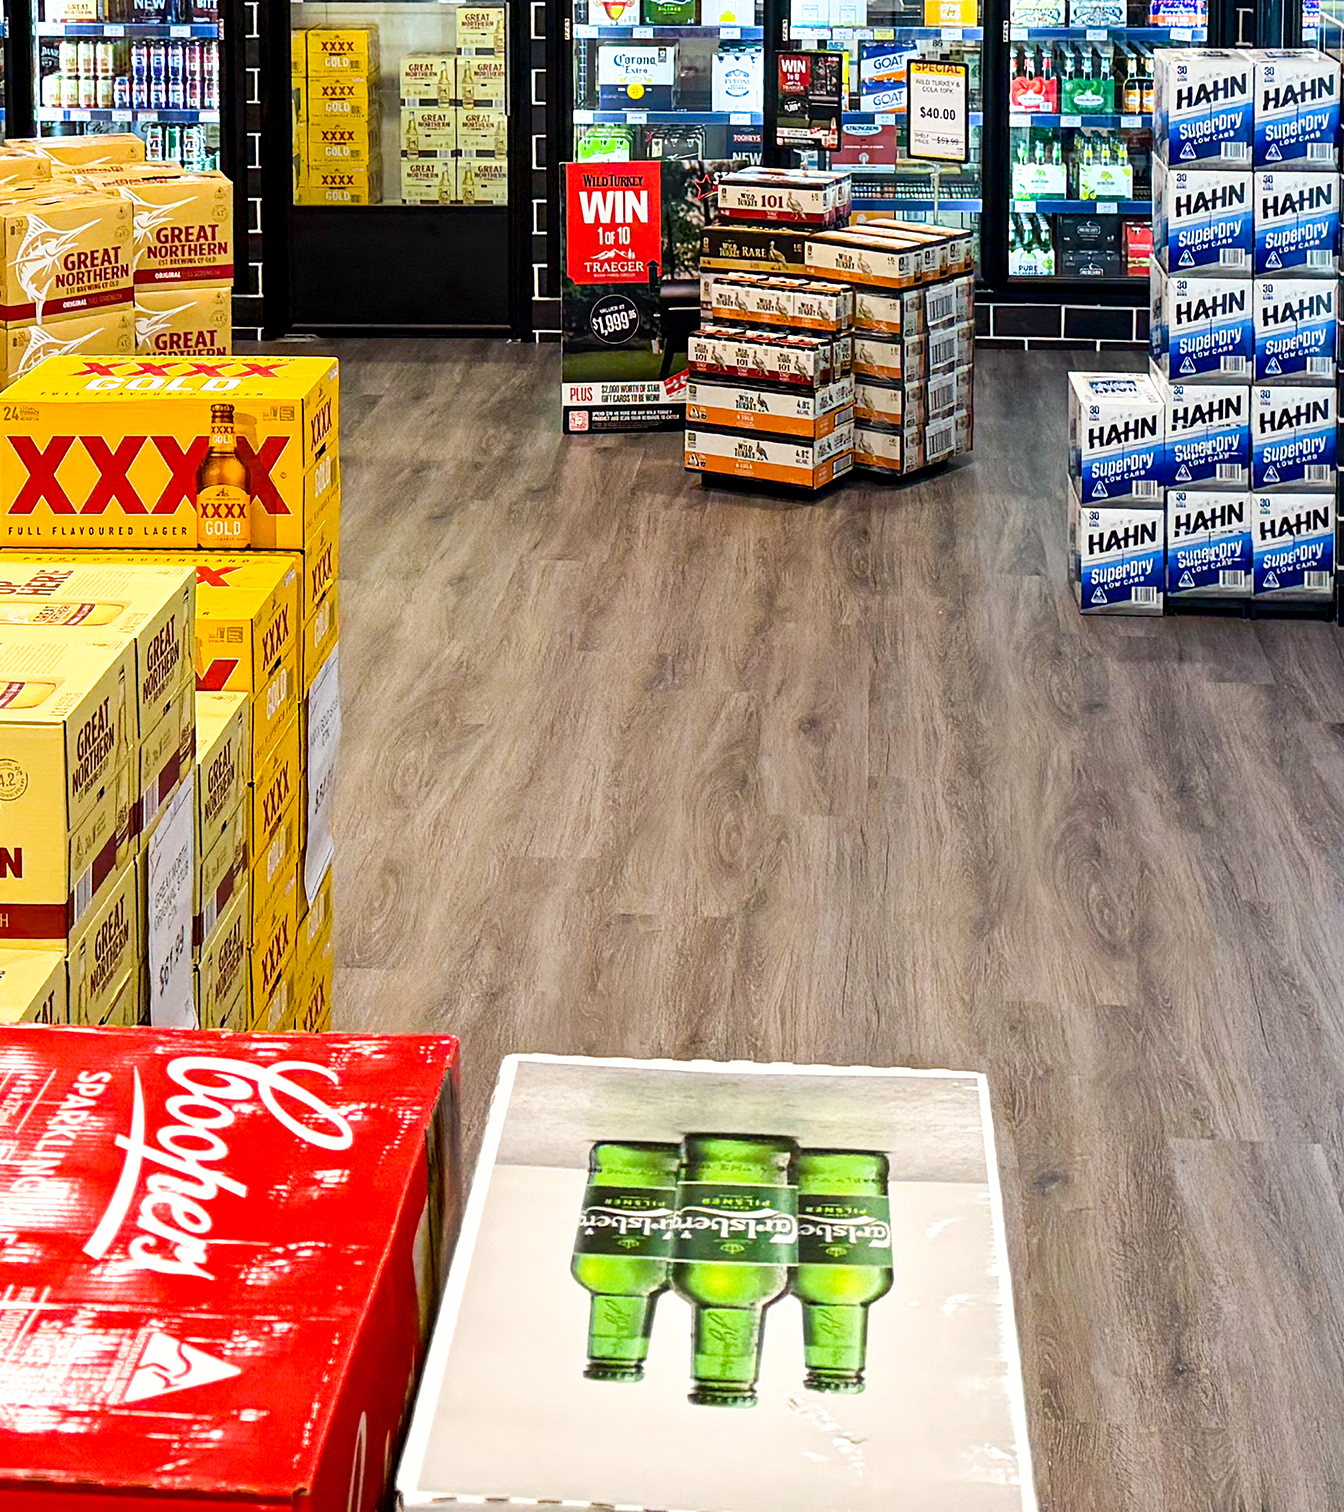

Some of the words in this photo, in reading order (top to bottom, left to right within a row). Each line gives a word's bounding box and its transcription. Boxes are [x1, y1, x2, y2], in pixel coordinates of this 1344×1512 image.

[614, 55, 656, 68] Corona
[781, 59, 806, 73] WIN
[874, 55, 904, 70] GOAT
[915, 63, 961, 73] SPECIAL
[873, 91, 903, 106] GOAT
[1176, 74, 1247, 110] HAHN
[1262, 74, 1334, 110] HAHN
[921, 107, 956, 121] $40.00
[1194, 136, 1210, 145] LOW
[1212, 130, 1234, 140] CARB
[583, 174, 606, 187] WILD
[608, 175, 643, 187] TURKEY
[579, 190, 648, 224] WIN
[761, 196, 783, 208] 101
[1175, 182, 1245, 217] HAHN
[156, 224, 218, 244] GREAT
[598, 228, 603, 244] 1
[617, 227, 630, 244] 10
[147, 242, 228, 259] NORTHERN
[742, 247, 766, 257] RARE
[63, 247, 121, 271] GREAT
[584, 262, 644, 272] TRAEGER
[56, 264, 129, 288] NORTHERN
[63, 299, 87, 308] ORIGINAL
[70, 362, 288, 378] XXXX
[84, 377, 244, 391] GOLD
[570, 387, 592, 401] PLUS
[4, 406, 18, 421] 24
[1260, 398, 1328, 433] HAHN
[1088, 416, 1157, 449] HAHN
[6, 436, 293, 515] XXXX
[200, 503, 246, 518] XXXX
[8, 526, 42, 536] FULL
[53, 526, 134, 536] FLAVOURED
[144, 526, 188, 536] LAGER
[206, 520, 241, 536] GOLD
[77, 697, 111, 761] GREAT
[72, 724, 115, 797] NORTHERN
